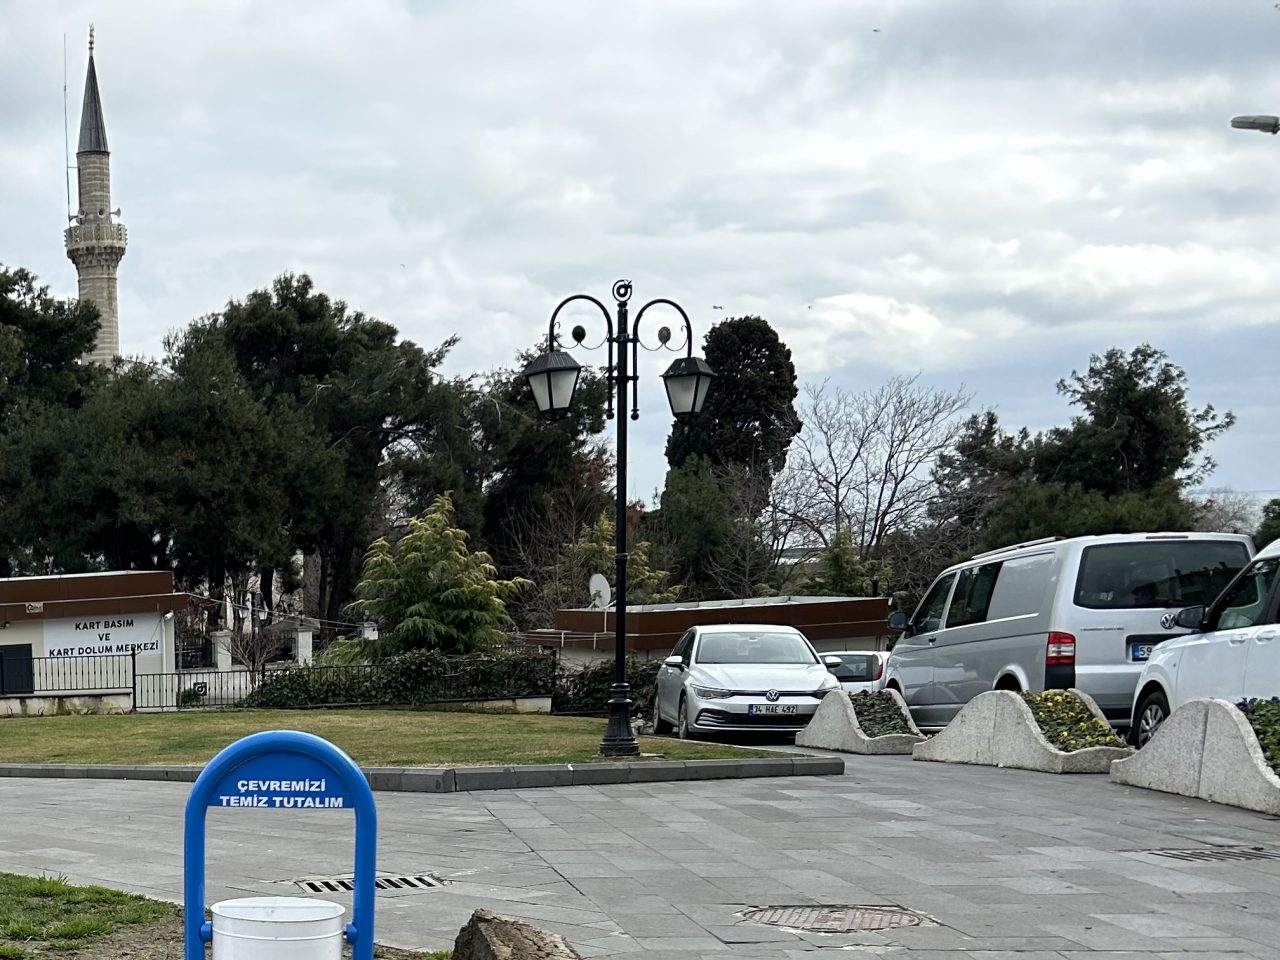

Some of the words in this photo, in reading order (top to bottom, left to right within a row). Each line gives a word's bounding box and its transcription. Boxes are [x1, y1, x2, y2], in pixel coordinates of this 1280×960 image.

[75, 621, 100, 631] KART
[104, 619, 134, 629] BASIM
[98, 633, 111, 641] VE
[49, 647, 75, 657] KART
[78, 645, 113, 655] DOLUM
[116, 640, 159, 653] MERKEZİ
[754, 705, 762, 714] 34
[782, 705, 796, 714] 492
[237, 778, 326, 793] ÇEVREMİZİ
[219, 794, 269, 807] TEMİZ
[272, 797, 344, 808] TUTALIM
